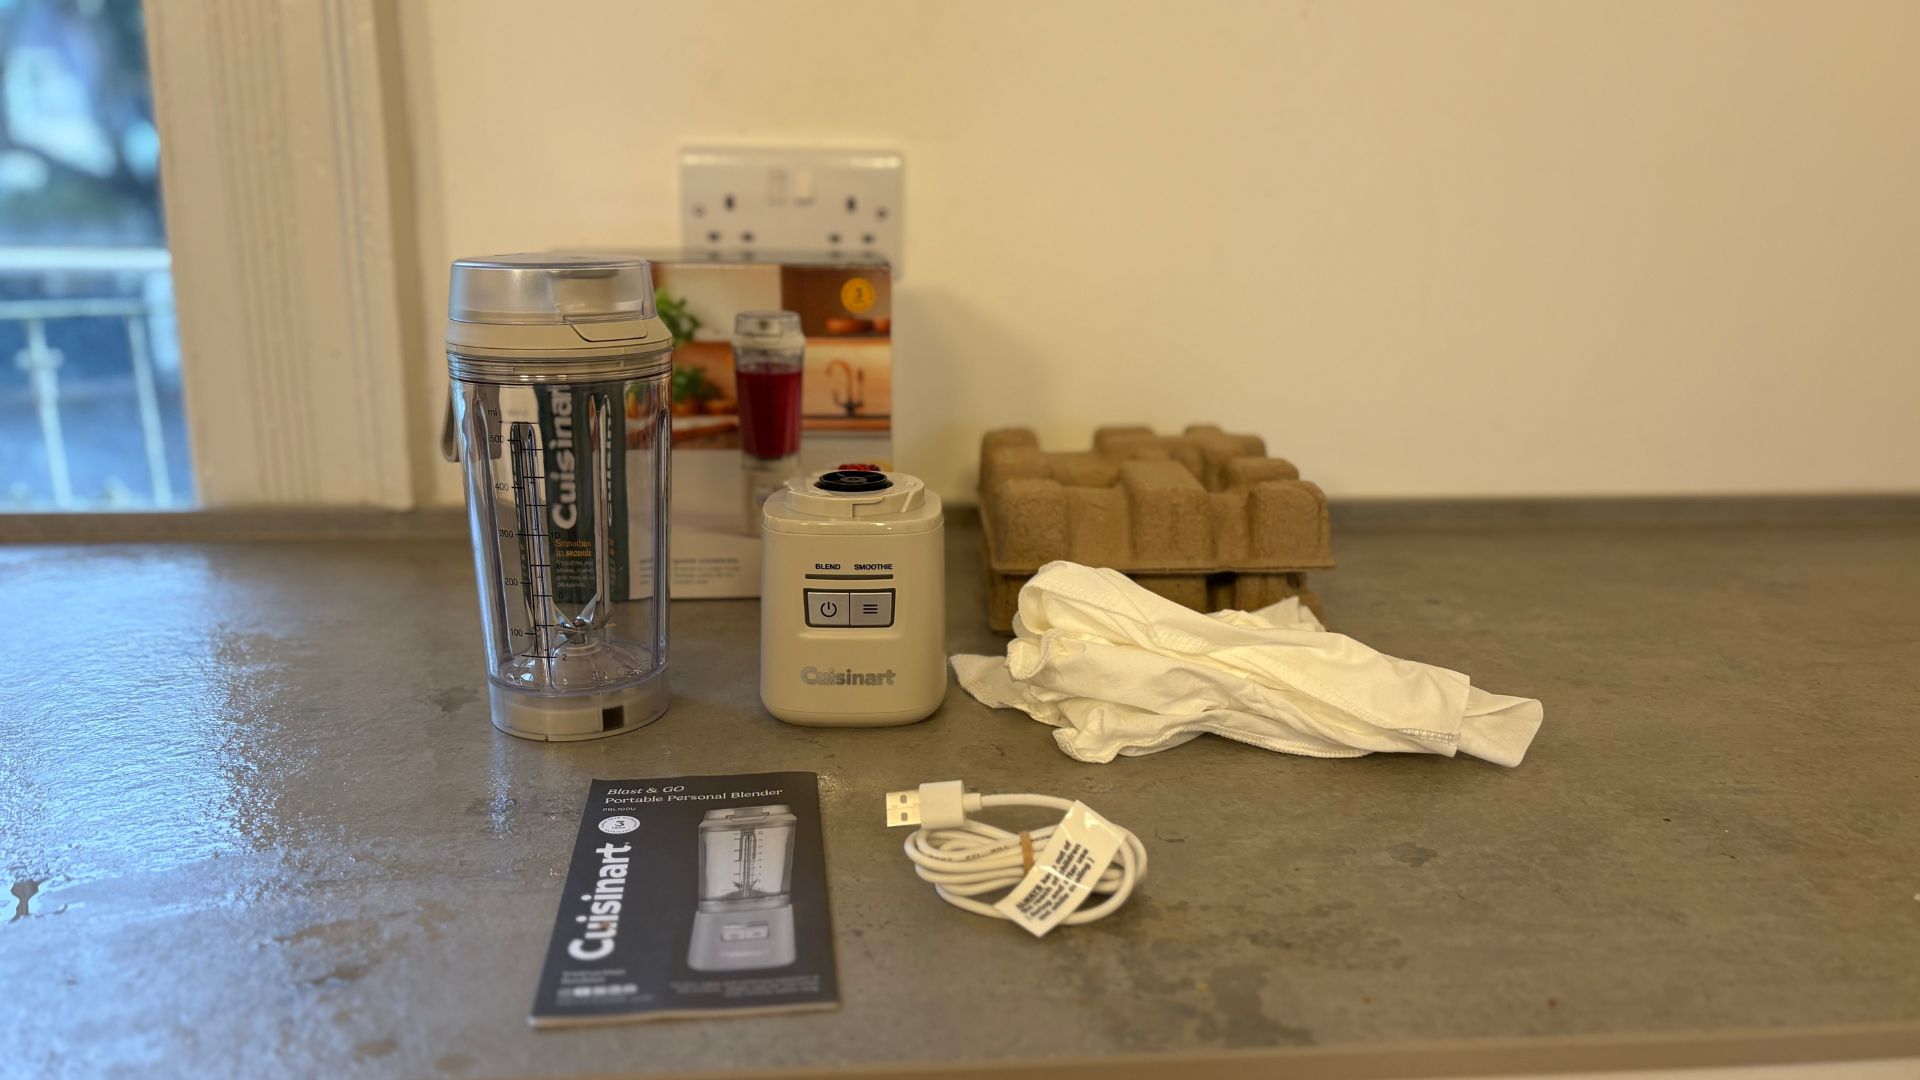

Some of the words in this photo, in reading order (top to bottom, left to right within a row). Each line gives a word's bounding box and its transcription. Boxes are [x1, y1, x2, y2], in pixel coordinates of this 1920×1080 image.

[490, 434, 504, 444] 500
[495, 482, 509, 491] 400
[500, 529, 514, 538] 300
[504, 578, 518, 586] 200
[510, 628, 522, 638] 100
[562, 653, 568, 661] 2
[801, 666, 896, 686] Cuisinart
[662, 785, 685, 793] GO
[604, 795, 664, 804] Portable
[667, 792, 726, 802] Personal
[730, 789, 783, 799] Blender
[1056, 851, 1066, 864] out
[1064, 840, 1071, 850] of
[1052, 885, 1064, 899] and
[1076, 849, 1088, 864] use
[568, 842, 632, 961] Cuisinart
